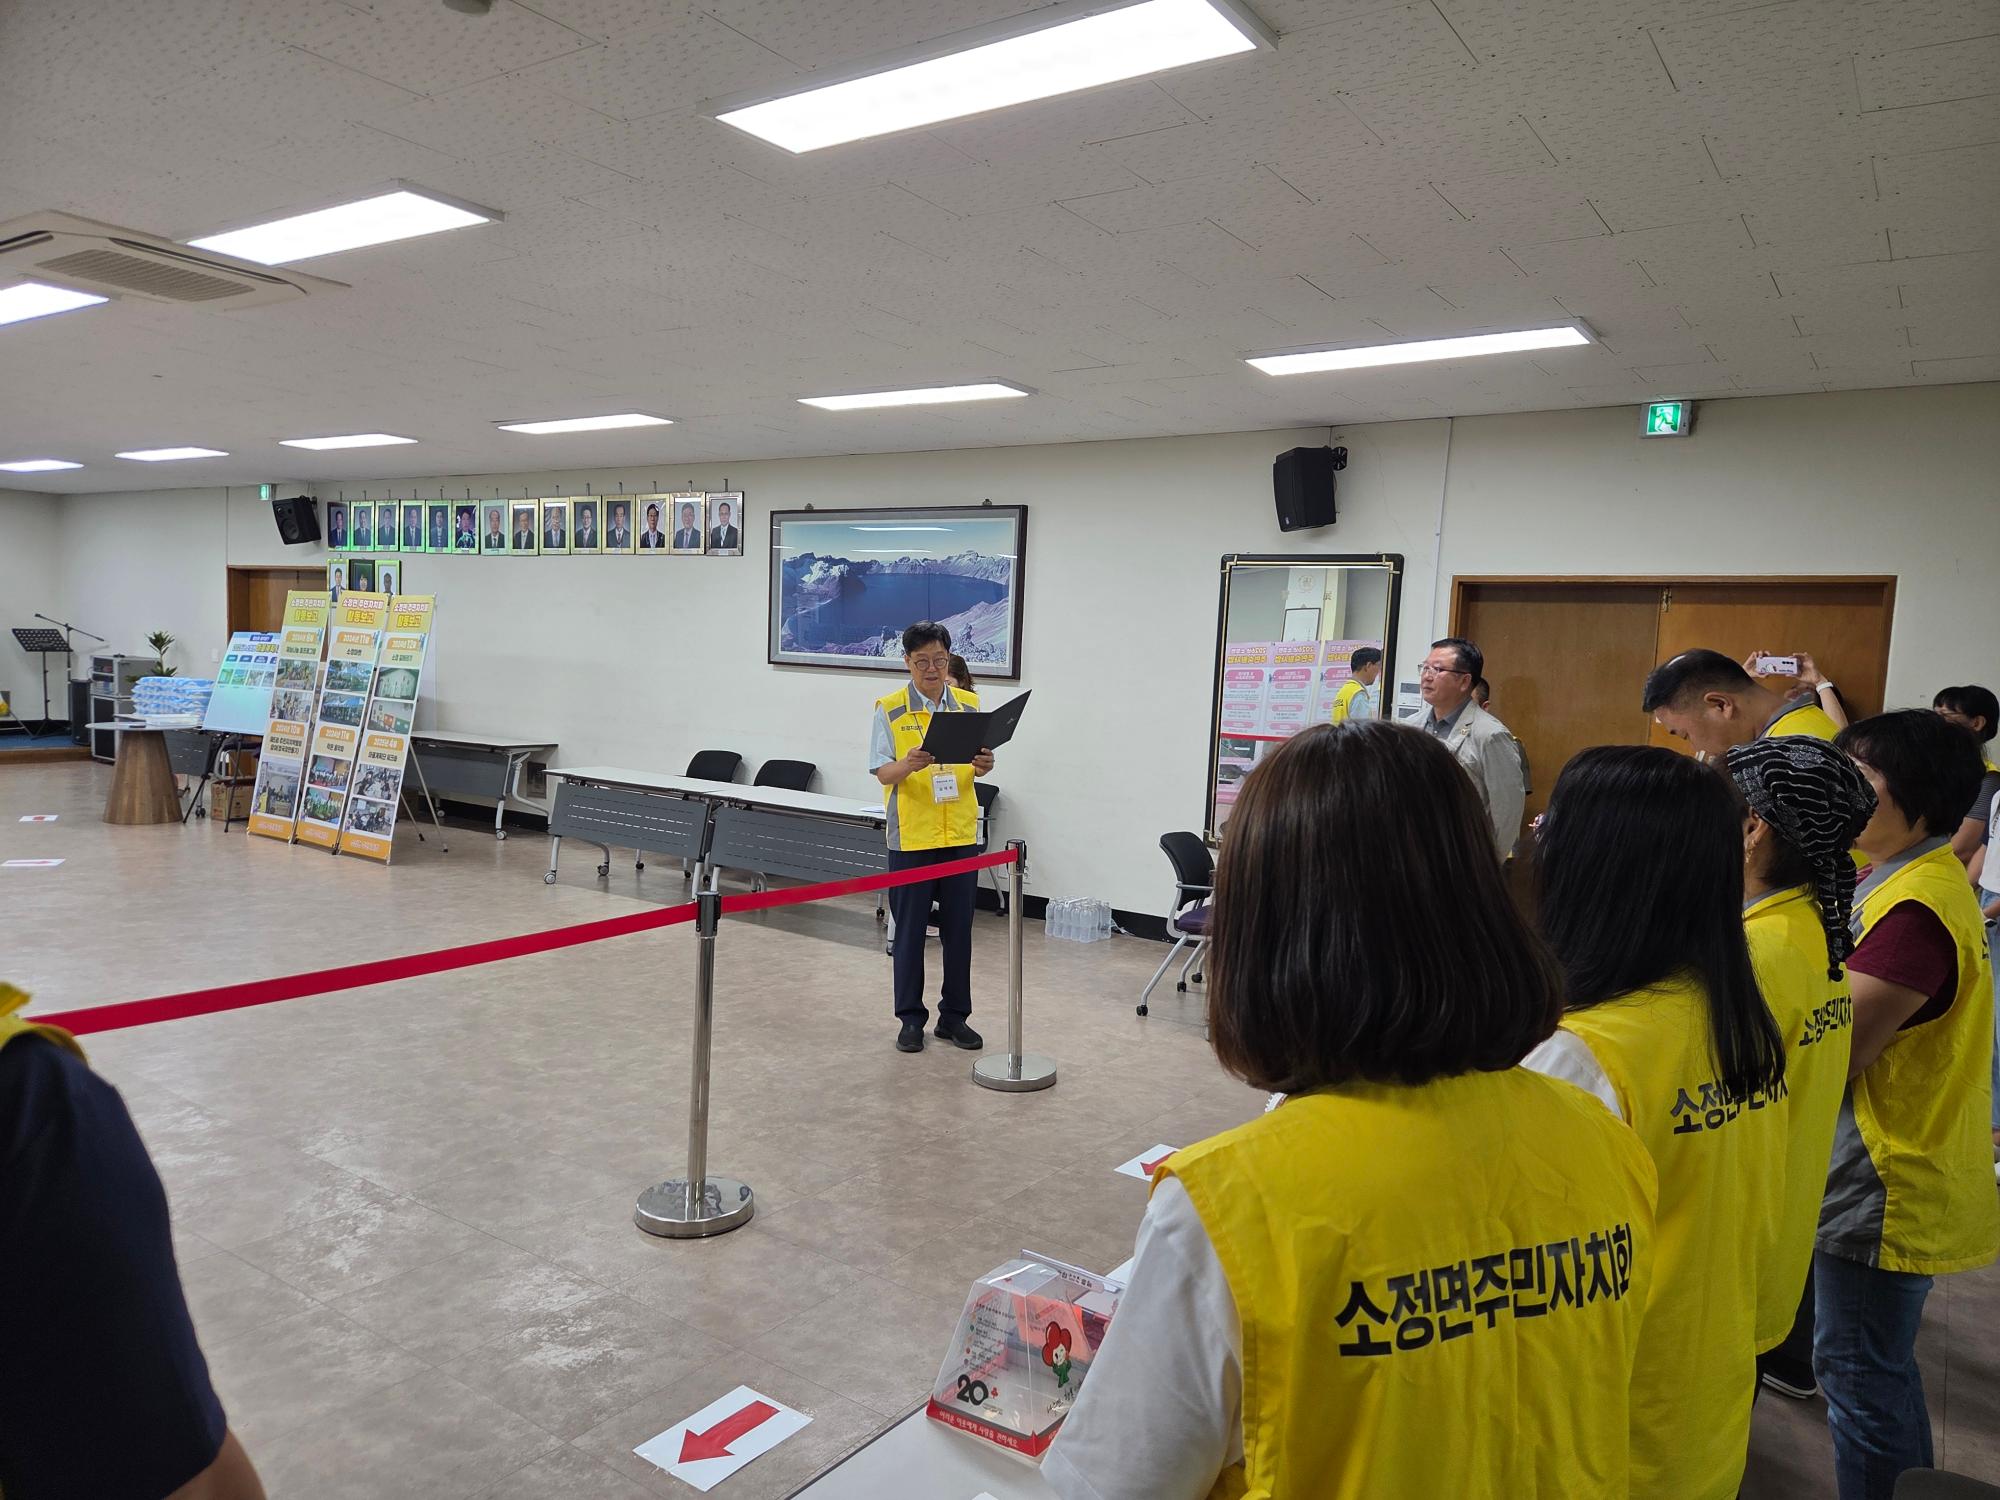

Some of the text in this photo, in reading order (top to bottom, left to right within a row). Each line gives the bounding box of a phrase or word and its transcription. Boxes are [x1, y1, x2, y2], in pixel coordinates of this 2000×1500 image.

[342, 599, 385, 610] 소정면 주민자치회
[346, 610, 376, 624] 활동보고
[396, 614, 422, 628] 활동보고
[1334, 1223, 1632, 1356] 소정면주민자치회
[956, 1374, 989, 1406] 20
